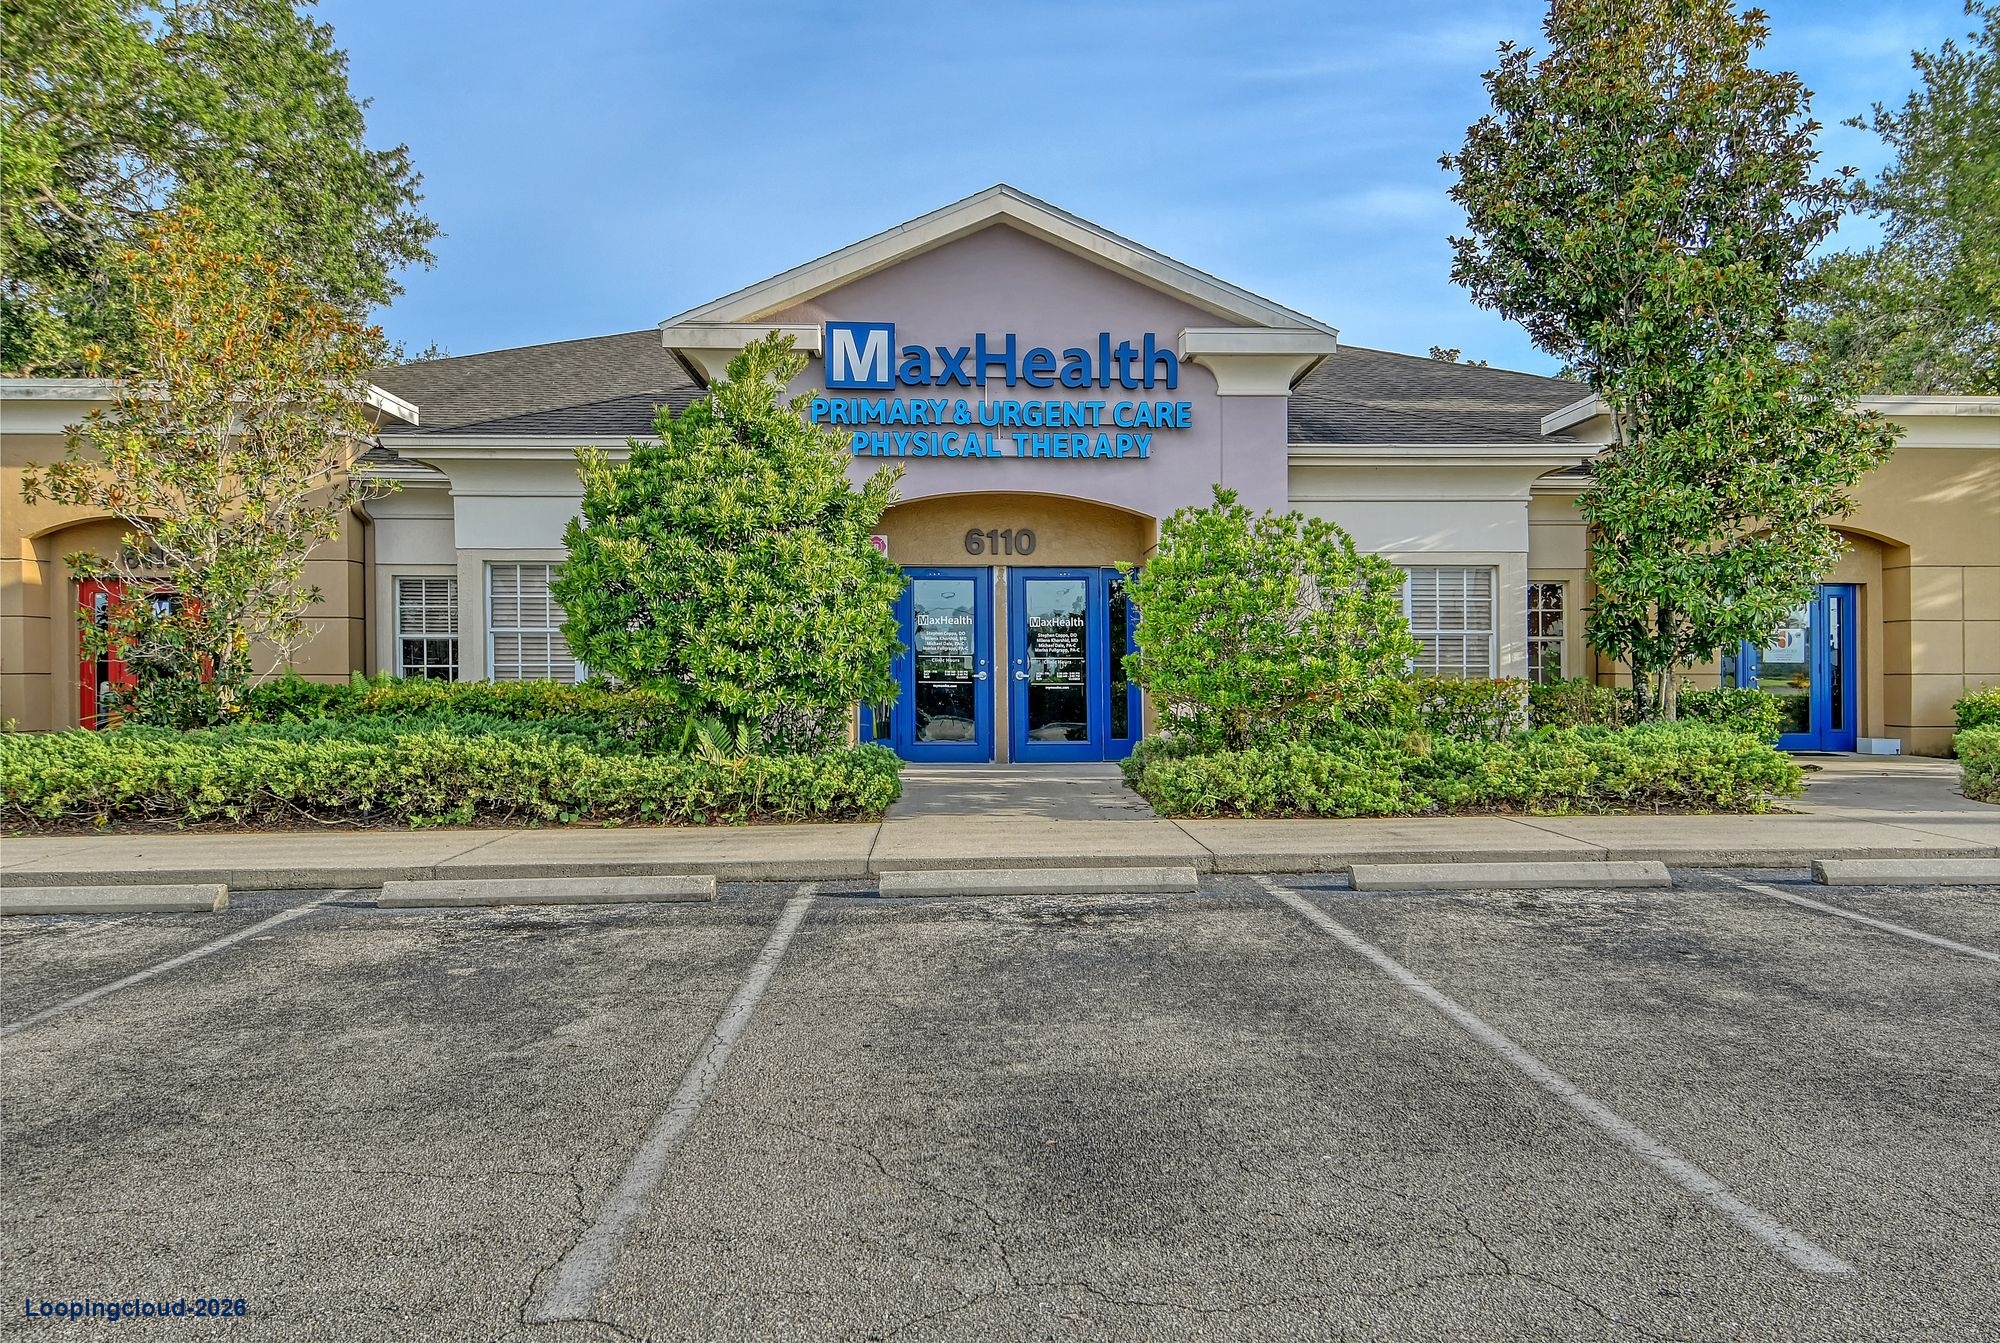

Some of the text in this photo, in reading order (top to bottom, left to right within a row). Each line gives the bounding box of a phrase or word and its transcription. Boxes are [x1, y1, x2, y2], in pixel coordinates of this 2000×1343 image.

[826, 321, 1179, 391] MaxHealth
[811, 397, 1192, 429] PRIMARY & URGENT CARE
[852, 430, 1152, 460] PHYSICAL THERAPY
[965, 528, 1036, 555] 6110
[917, 614, 973, 626] MaxHealth
[1029, 616, 1084, 628] MaxHealth
